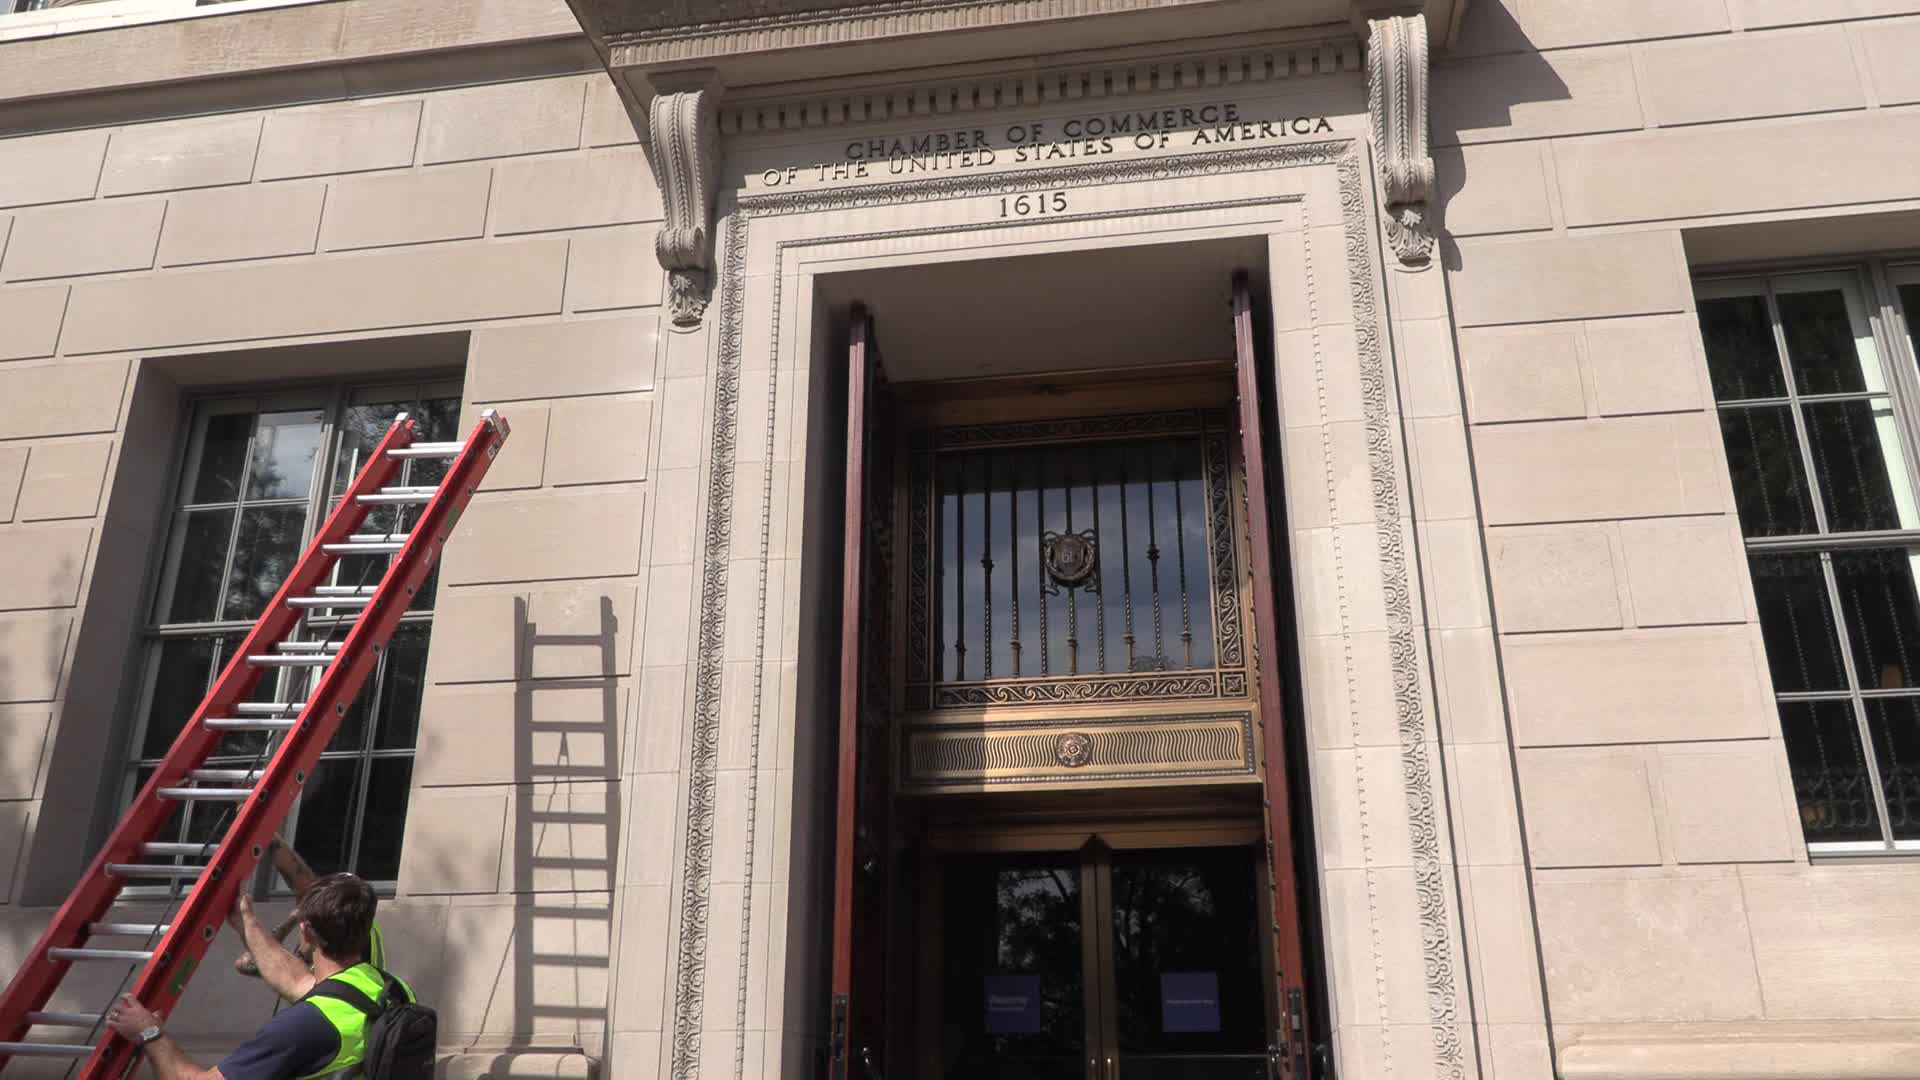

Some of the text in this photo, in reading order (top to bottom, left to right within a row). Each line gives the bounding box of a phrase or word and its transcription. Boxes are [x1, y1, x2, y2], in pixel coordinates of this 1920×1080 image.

[762, 115, 1334, 187] OF THE UNITED STATES OF AMERICA
[847, 103, 1240, 160] CHAMBER OF COMMERCE
[1000, 191, 1067, 217] 1615
